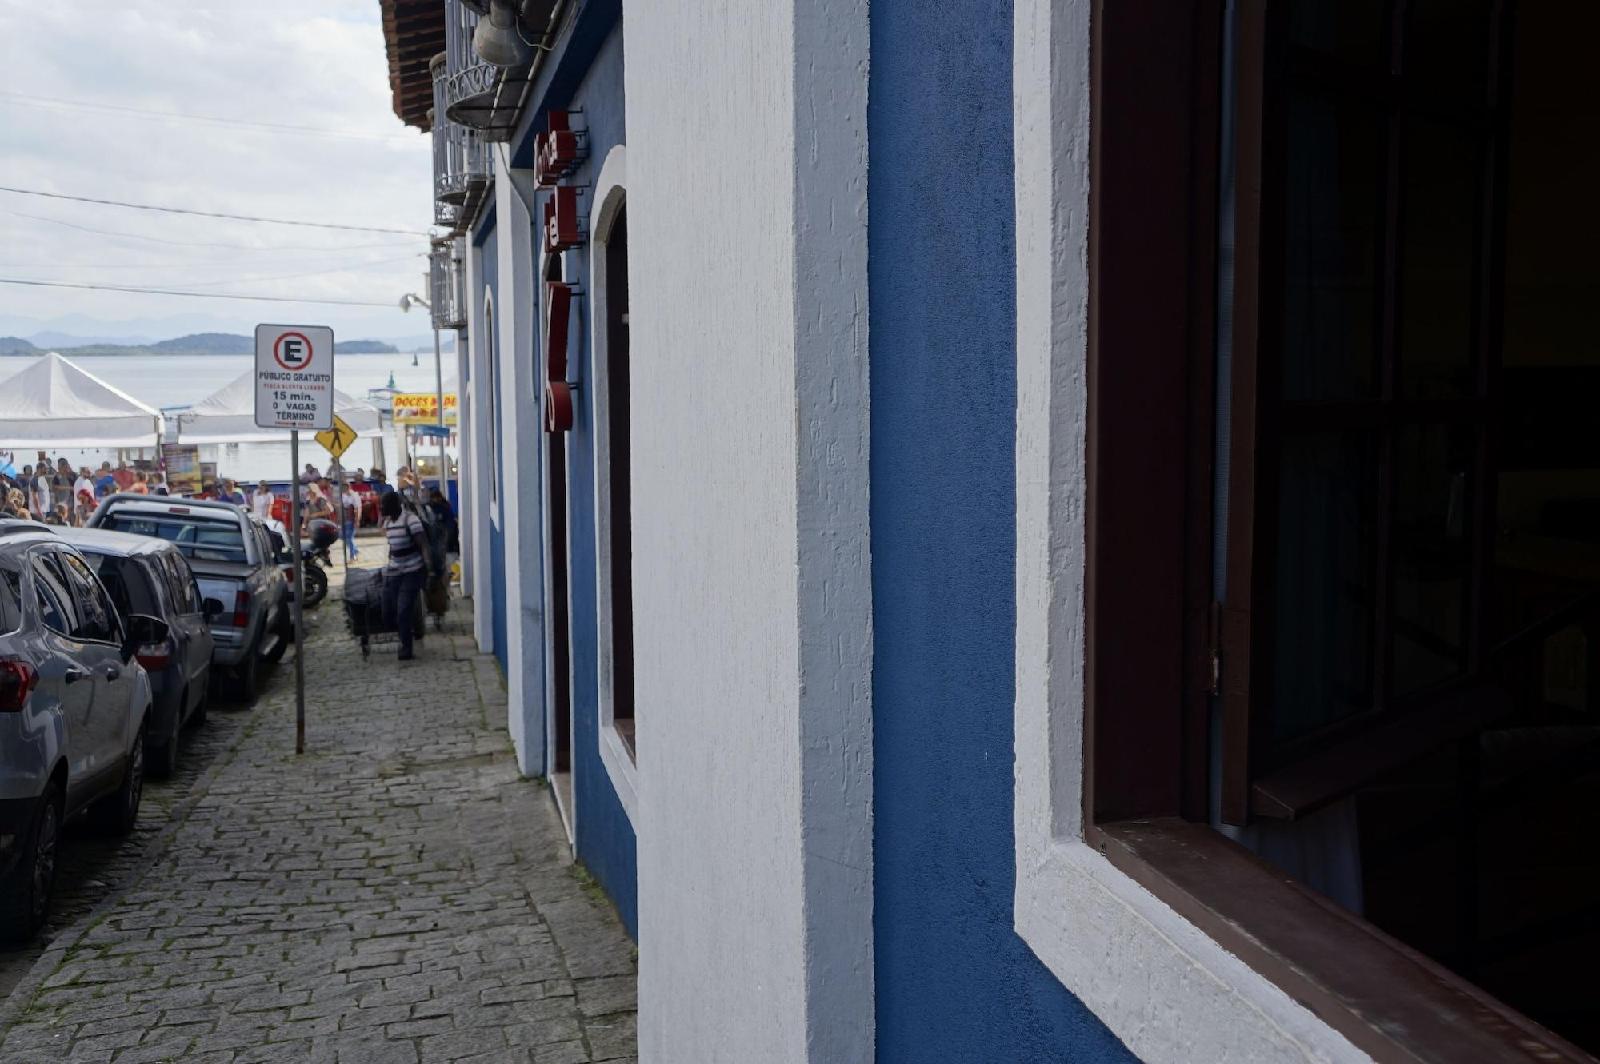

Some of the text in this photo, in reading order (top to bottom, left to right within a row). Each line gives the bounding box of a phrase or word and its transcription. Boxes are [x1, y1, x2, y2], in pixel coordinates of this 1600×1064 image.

[284, 340, 302, 362] E
[293, 373, 331, 382] GRATUITO
[273, 391, 315, 401] 15 min.
[286, 402, 317, 411] VAGAS
